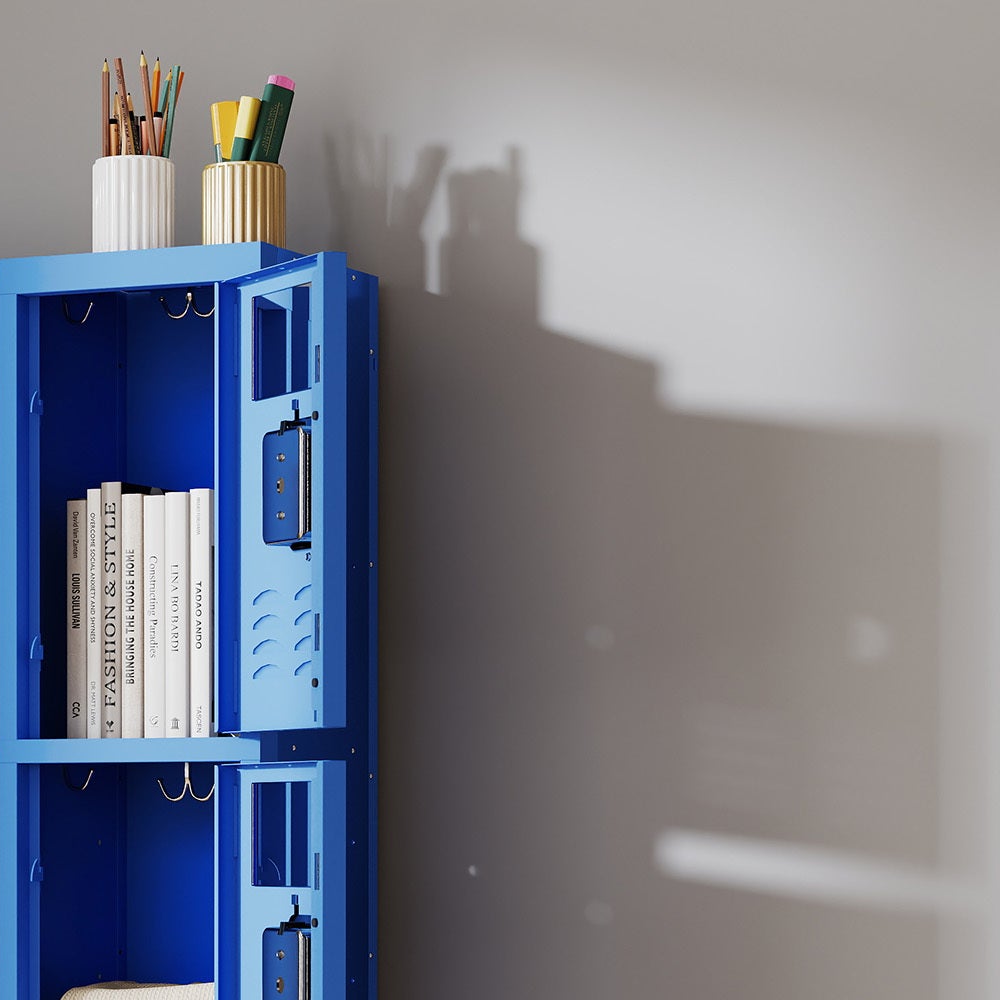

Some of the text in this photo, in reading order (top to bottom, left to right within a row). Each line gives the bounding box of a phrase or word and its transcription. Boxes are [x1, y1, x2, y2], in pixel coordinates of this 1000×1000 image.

[72, 573, 80, 629] LOUIS SULLIVAN
[105, 503, 116, 707] FASHION & STYLE
[126, 548, 135, 684] BRINGING THE HOUSE HOME
[149, 555, 158, 616] Constructing
[171, 564, 179, 652] LINA BO BARDI
[72, 701, 80, 718] CCA
